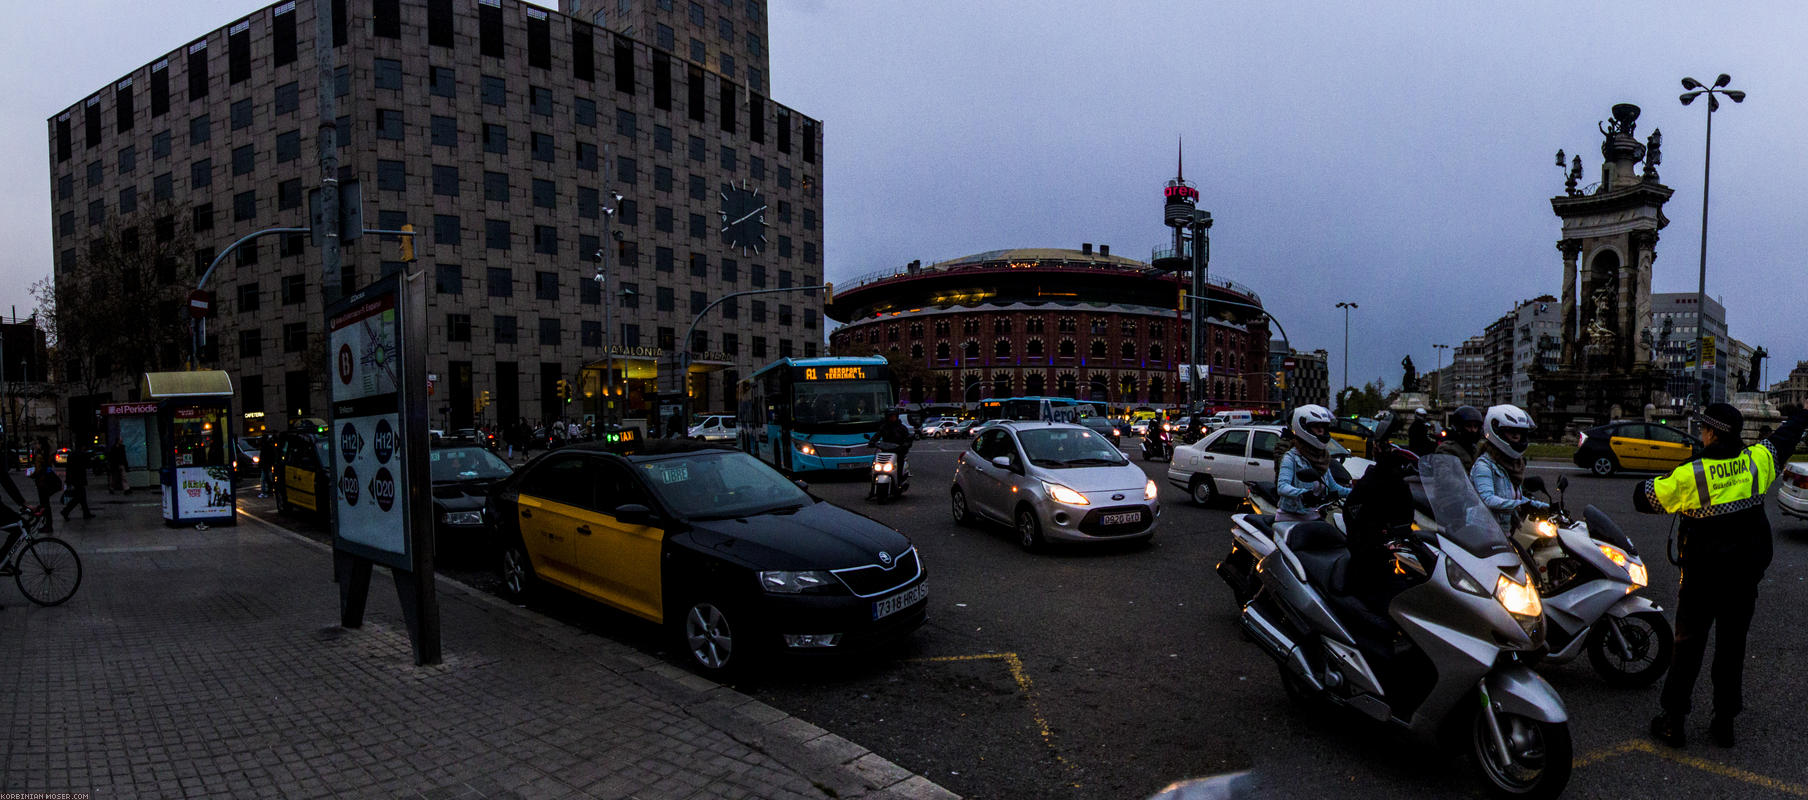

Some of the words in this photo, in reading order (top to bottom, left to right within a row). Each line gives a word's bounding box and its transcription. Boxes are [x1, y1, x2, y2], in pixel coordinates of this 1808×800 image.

[602, 344, 664, 357] CATALONIA
[806, 368, 818, 381] A1
[825, 372, 856, 380] TERMINAL
[828, 367, 862, 375] AEROPORT
[115, 405, 123, 414] el
[342, 434, 358, 450] H12
[375, 432, 393, 451] H12
[620, 430, 634, 442] TAXI
[1709, 458, 1749, 480] POLICIA
[662, 469, 689, 484] LIBRE
[344, 478, 359, 491] D20
[376, 480, 394, 498] D20
[878, 597, 902, 617] 7318
